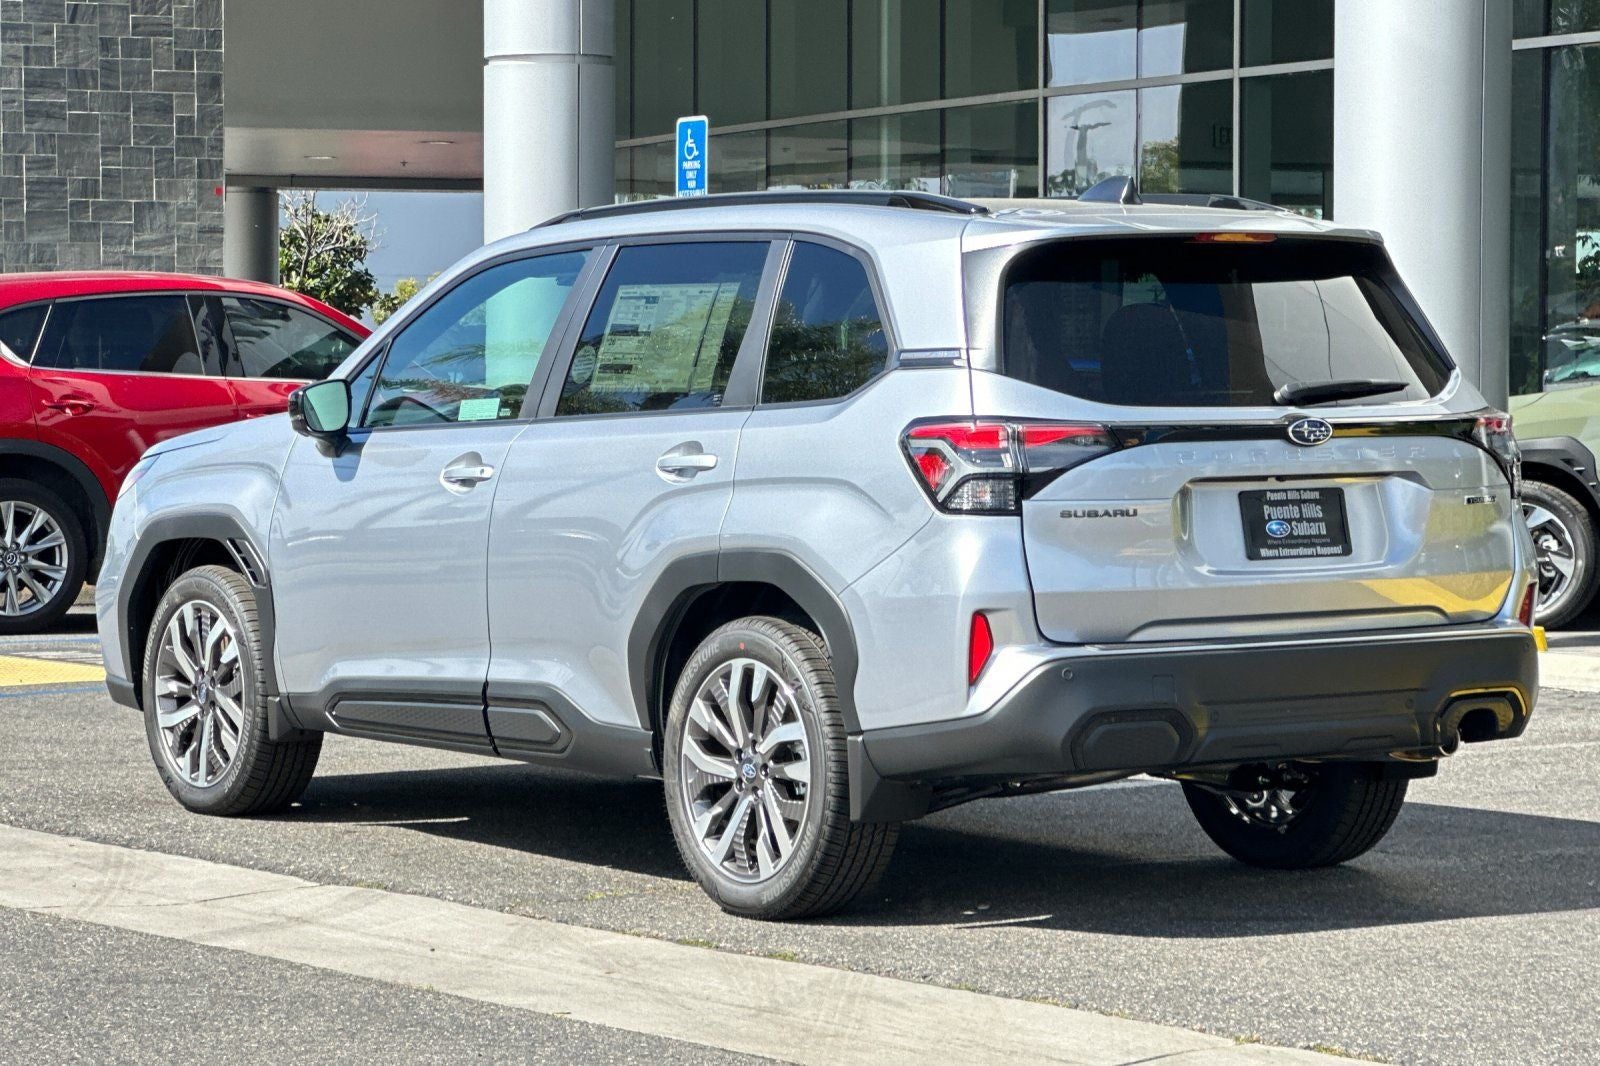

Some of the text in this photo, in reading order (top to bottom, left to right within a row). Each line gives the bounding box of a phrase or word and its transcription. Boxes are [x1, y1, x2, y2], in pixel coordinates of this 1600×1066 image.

[682, 160, 701, 170] PARKING
[685, 170, 698, 179] ONLY
[1266, 489, 1320, 501] Puente Hills Subaru
[1059, 508, 1138, 519] SUBARU
[1263, 502, 1324, 520] Puente Hills
[1291, 520, 1327, 536] Subaru
[1260, 544, 1343, 557] Where Extraordinary Happens!
[143, 601, 170, 682] BRIDGESTONE
[669, 642, 720, 722] BRIDGESTONE
[224, 707, 253, 795] BRIDGESTONE
[761, 820, 816, 906] BRIDGESTONE
